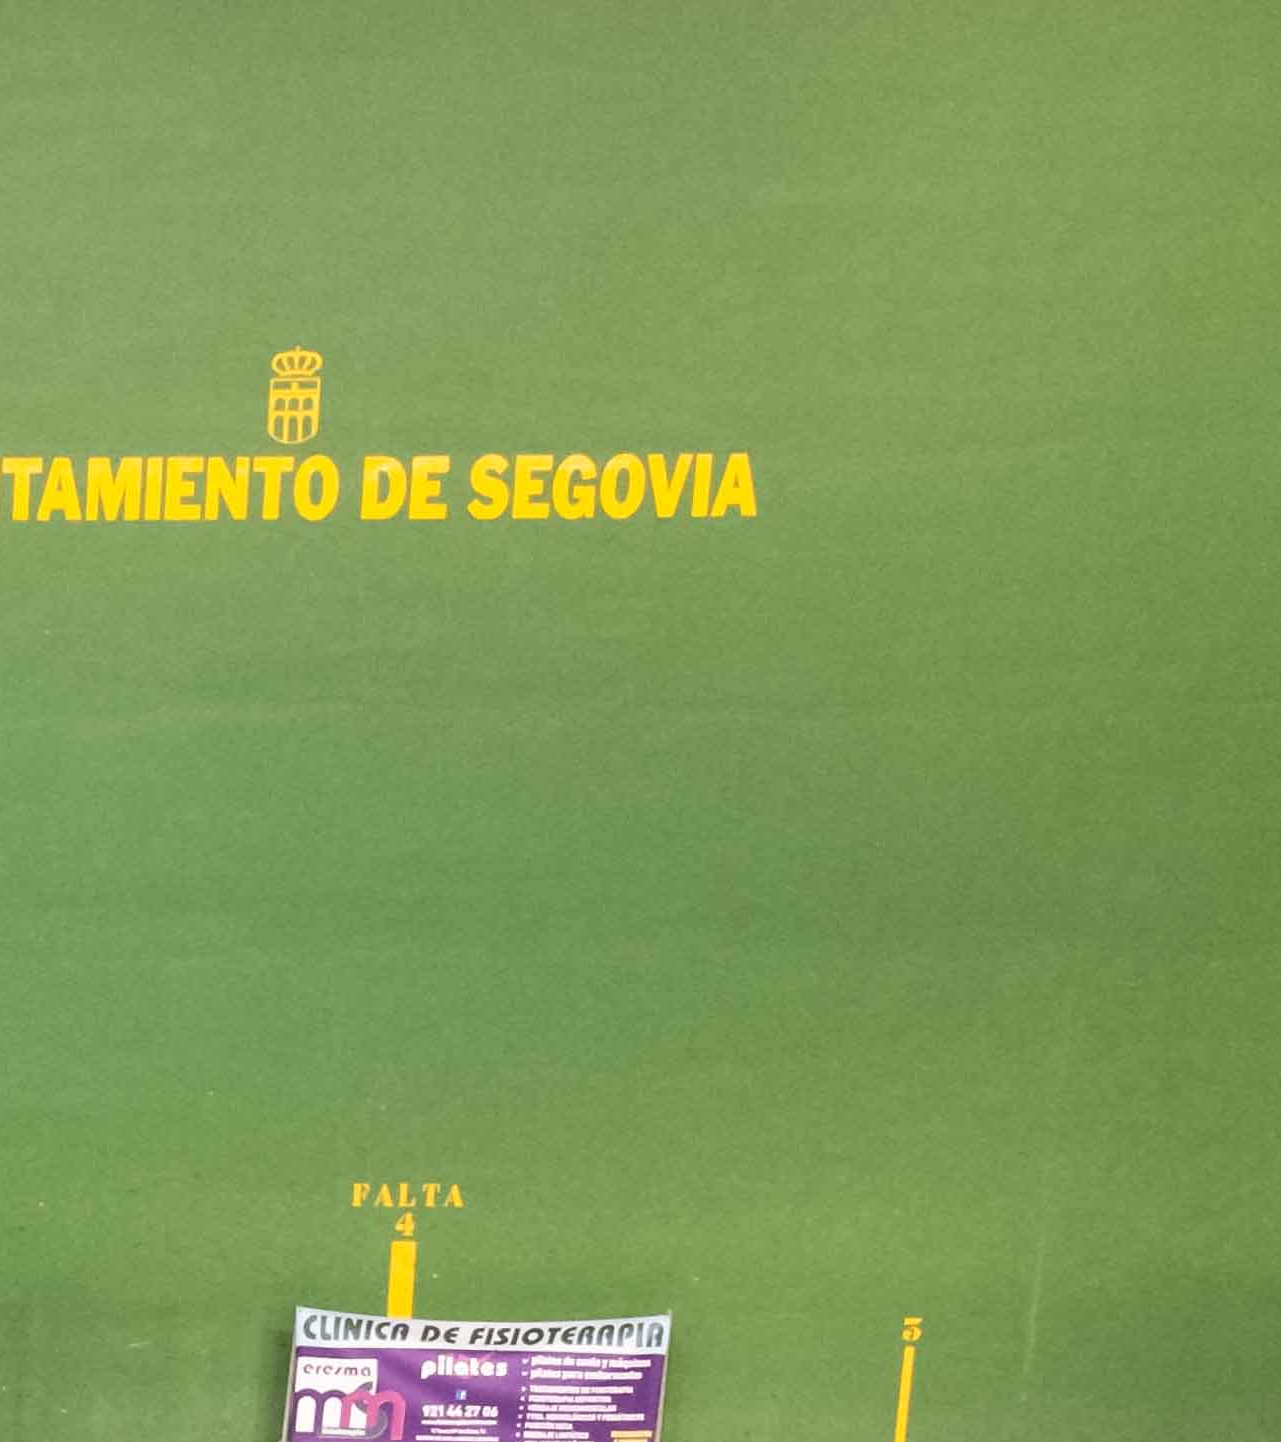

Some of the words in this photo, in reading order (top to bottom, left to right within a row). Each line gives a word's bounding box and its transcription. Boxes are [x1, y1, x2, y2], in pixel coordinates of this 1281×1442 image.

[359, 454, 451, 521] DE
[466, 452, 758, 521] SEGOVIA
[352, 1183, 464, 1208] FALTA
[395, 1212, 415, 1237] 4
[421, 1325, 460, 1344] DE
